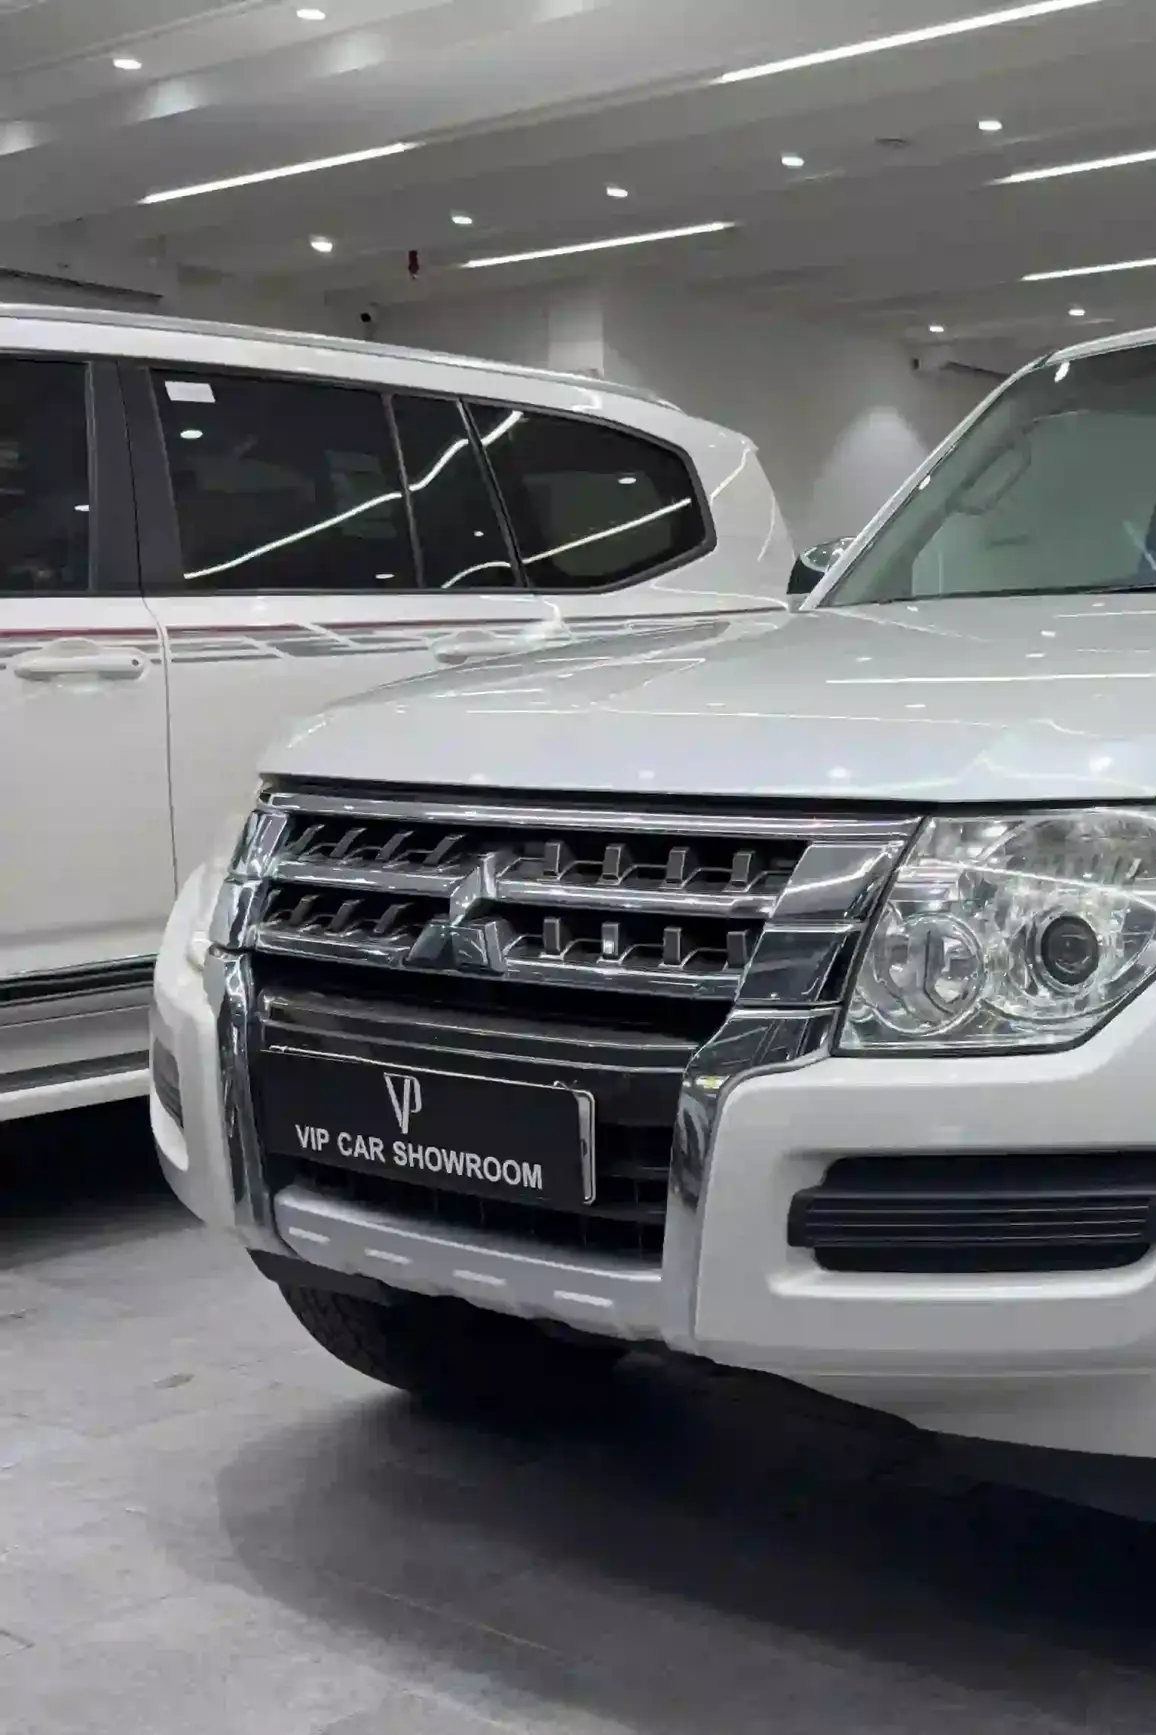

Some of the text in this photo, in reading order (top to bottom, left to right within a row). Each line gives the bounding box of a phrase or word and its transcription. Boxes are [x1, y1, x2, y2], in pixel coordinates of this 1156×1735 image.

[295, 1124, 543, 1190] VIP CAR SHOWROOM
